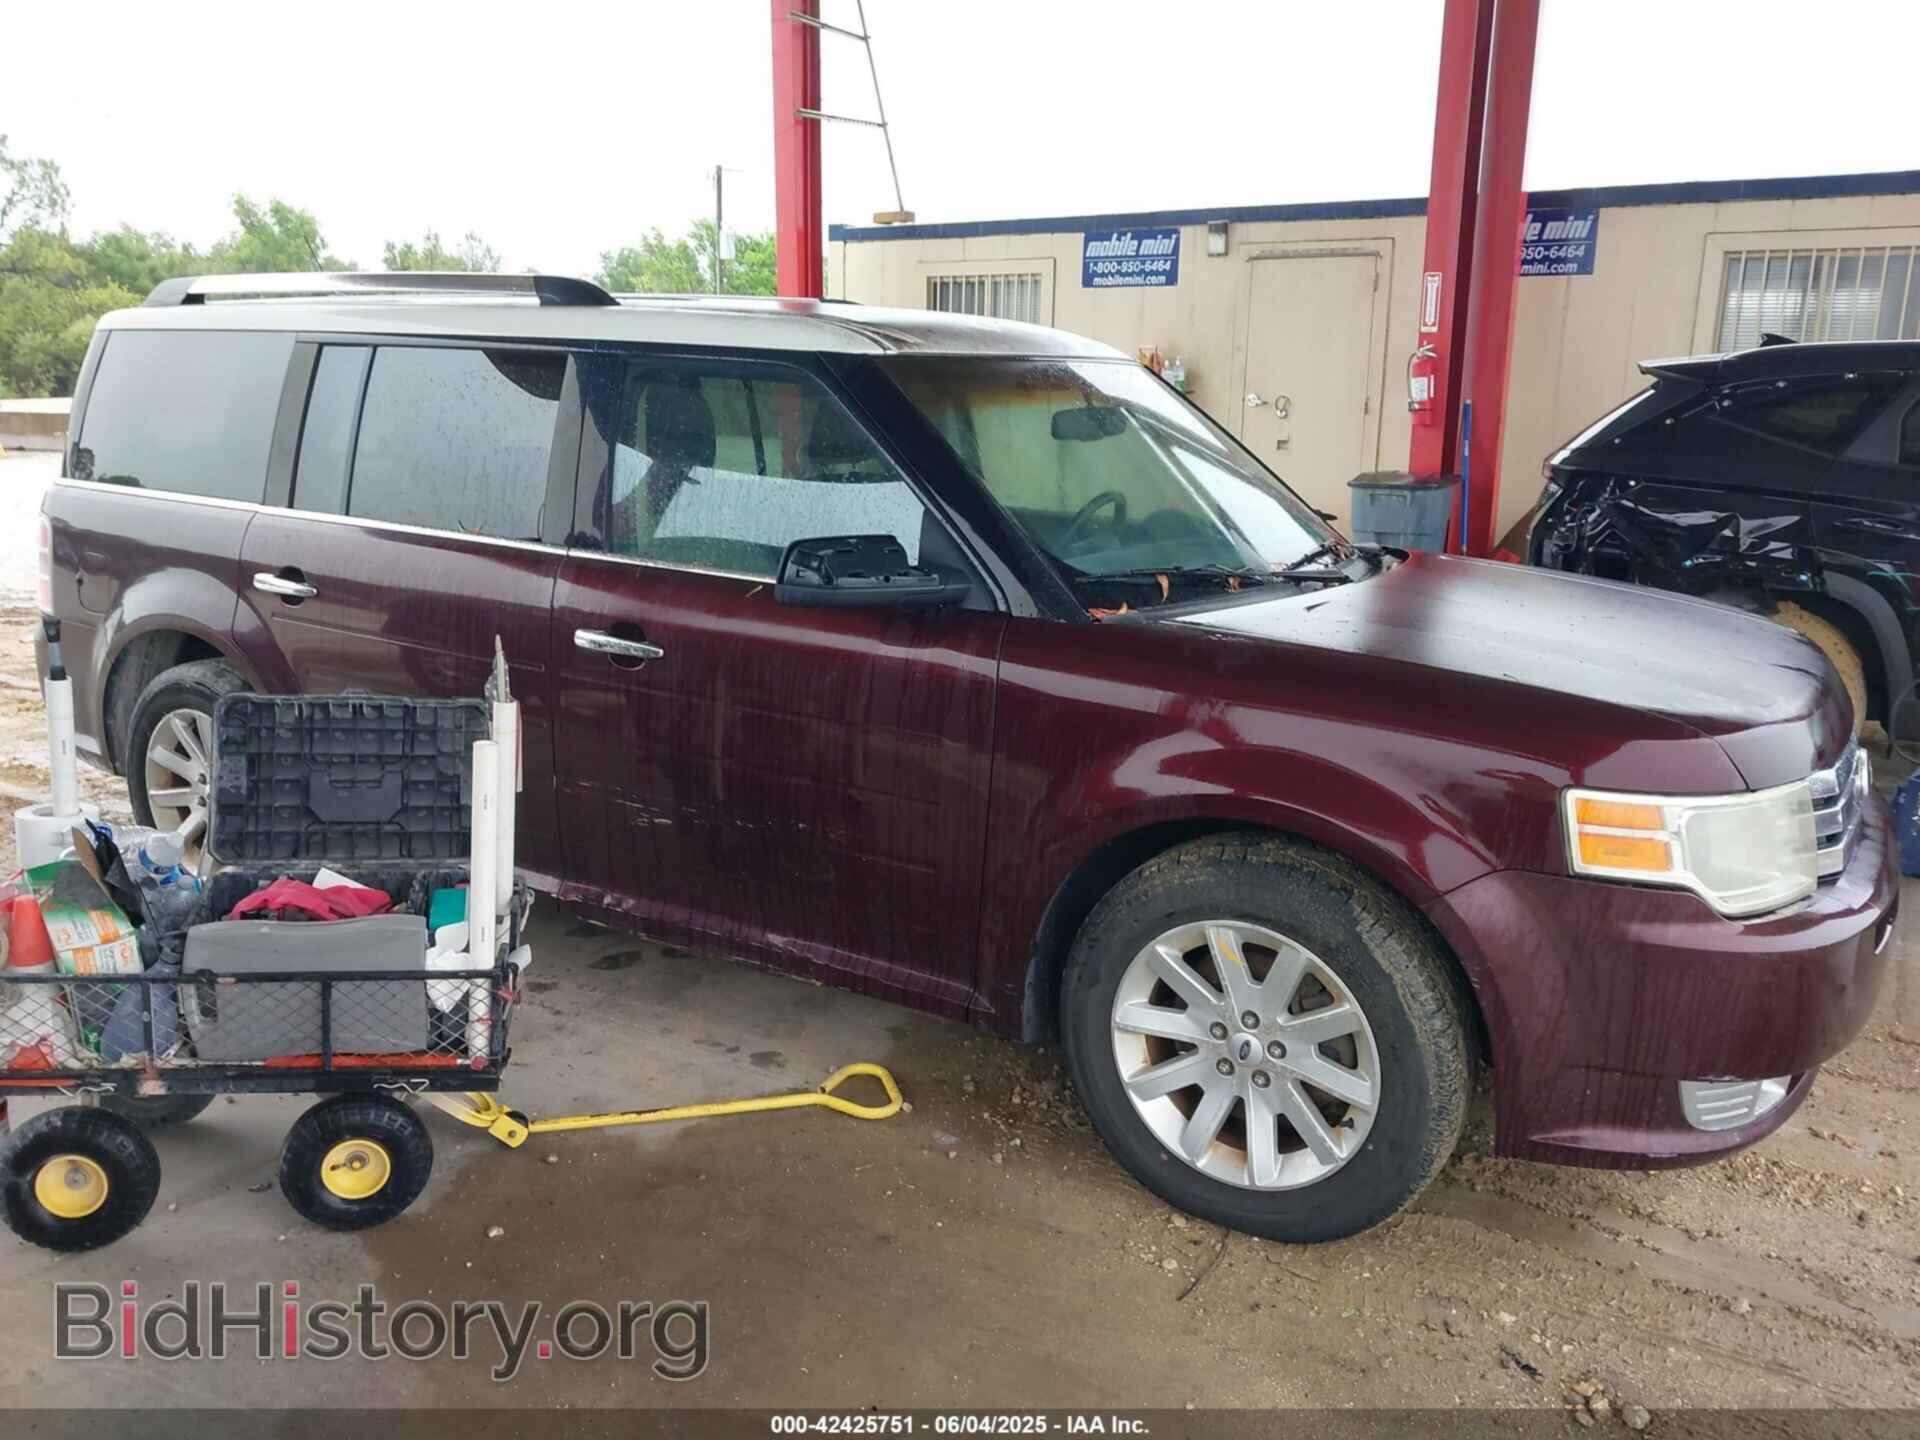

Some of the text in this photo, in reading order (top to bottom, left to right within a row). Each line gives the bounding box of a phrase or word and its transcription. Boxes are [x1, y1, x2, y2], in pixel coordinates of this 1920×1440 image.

[1542, 215, 1594, 240] mini
[1085, 232, 1177, 257] mobile mini
[1520, 244, 1586, 260] 950-6464
[1088, 260, 1172, 273] 1-800-950-6464
[1520, 261, 1578, 274] mini.com
[1092, 274, 1167, 286] mobilemini.com
